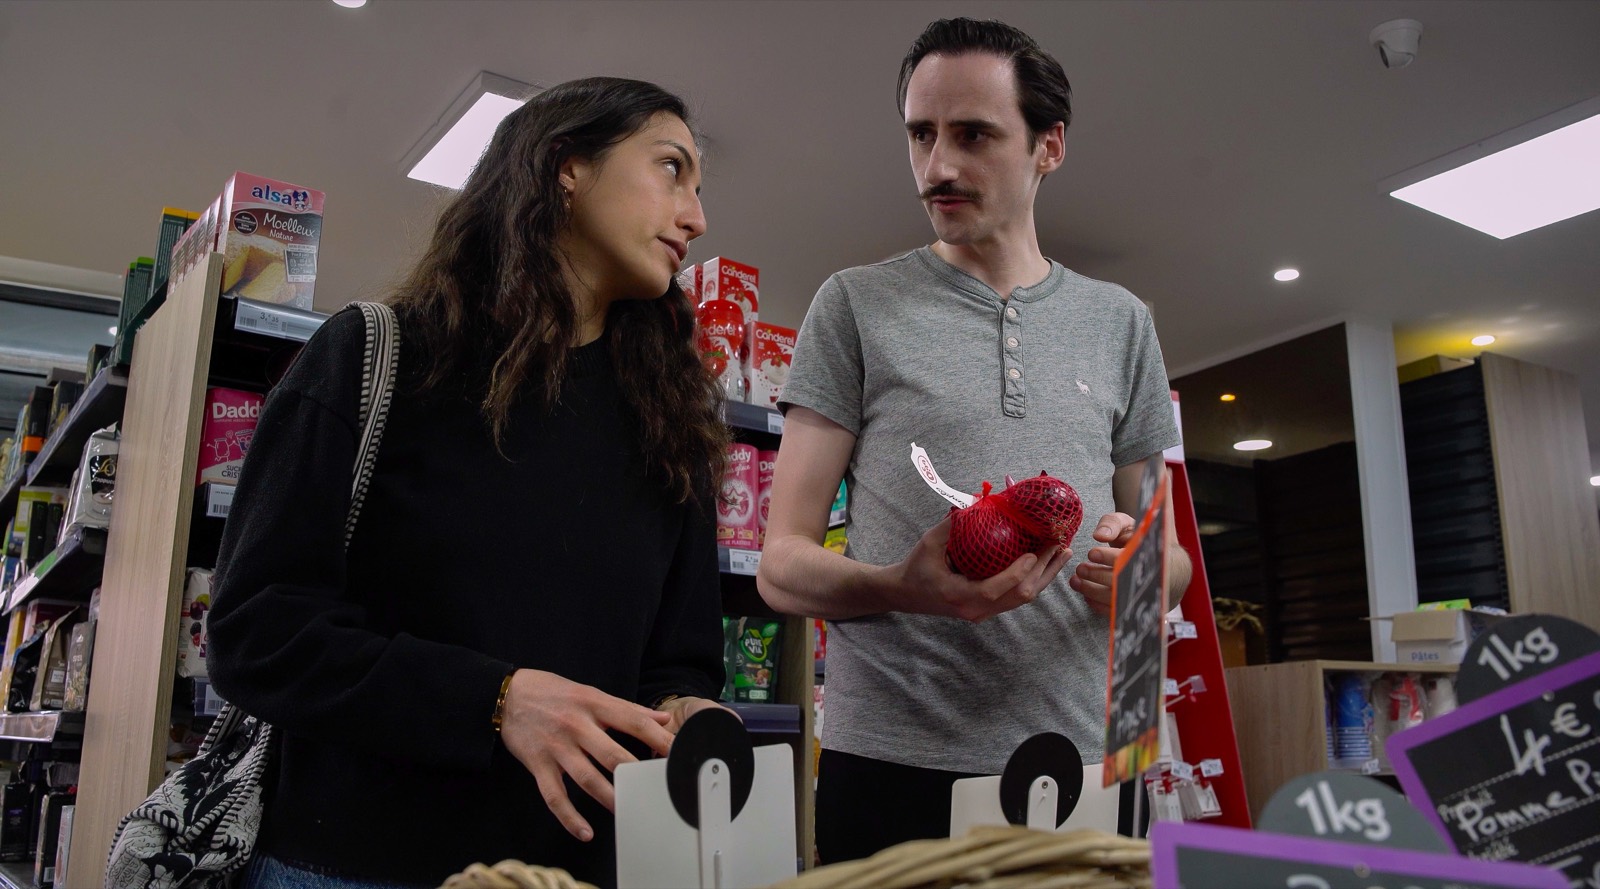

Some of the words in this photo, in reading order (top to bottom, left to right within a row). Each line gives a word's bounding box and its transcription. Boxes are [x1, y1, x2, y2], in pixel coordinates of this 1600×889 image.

[252, 184, 292, 206] alsa
[263, 212, 315, 237] Moelleux
[269, 229, 293, 241] Nature
[721, 266, 755, 283] Canderel
[701, 323, 736, 337] nderel
[756, 329, 794, 346] Canderel
[213, 401, 261, 419] Dadd
[728, 449, 751, 462] ddy
[221, 470, 240, 479] CRIST
[226, 464, 241, 472] SUC
[1477, 626, 1559, 681] 1kg
[1295, 781, 1391, 841] 1kg
[1455, 791, 1577, 842] Pomme
